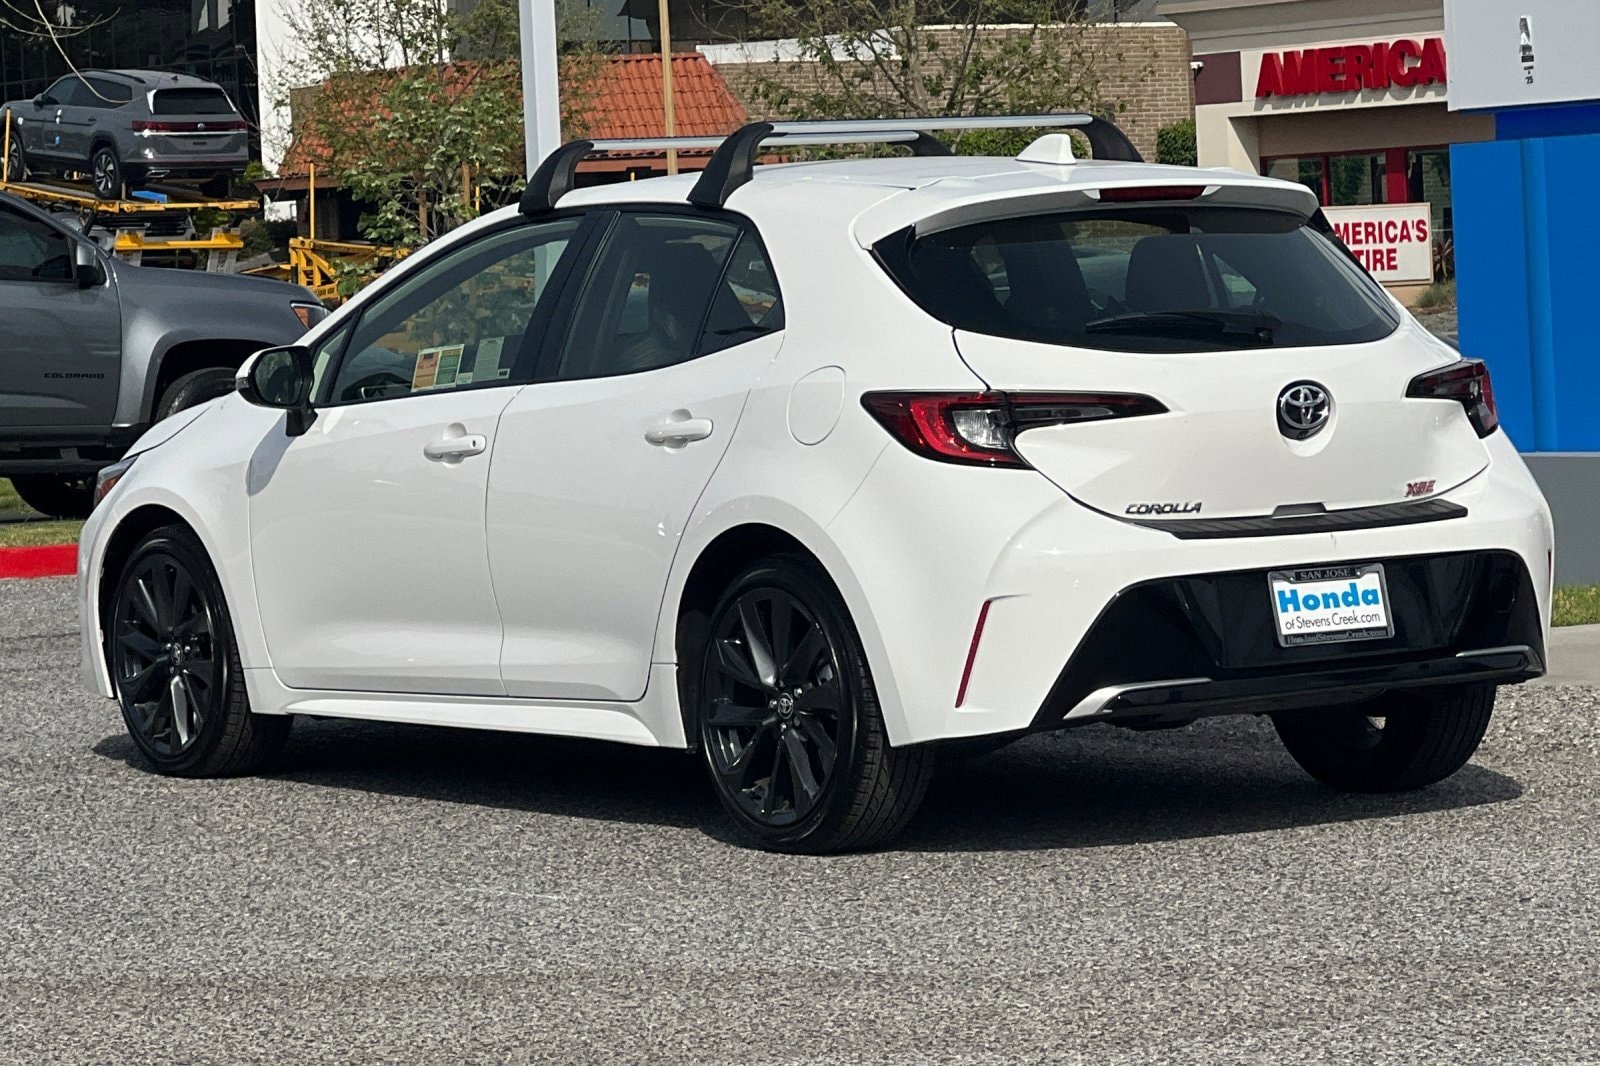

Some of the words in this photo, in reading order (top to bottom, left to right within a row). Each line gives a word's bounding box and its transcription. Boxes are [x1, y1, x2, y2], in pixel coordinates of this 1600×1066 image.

[1255, 37, 1447, 98] AMERICA
[1334, 218, 1428, 245] MERICA'S
[1125, 501, 1202, 515] COROLLA
[1300, 571, 1322, 580] SAN
[1324, 568, 1351, 578] JOSE
[1277, 582, 1380, 613] Honda
[1285, 621, 1294, 630] of
[1296, 616, 1331, 629] Stevens
